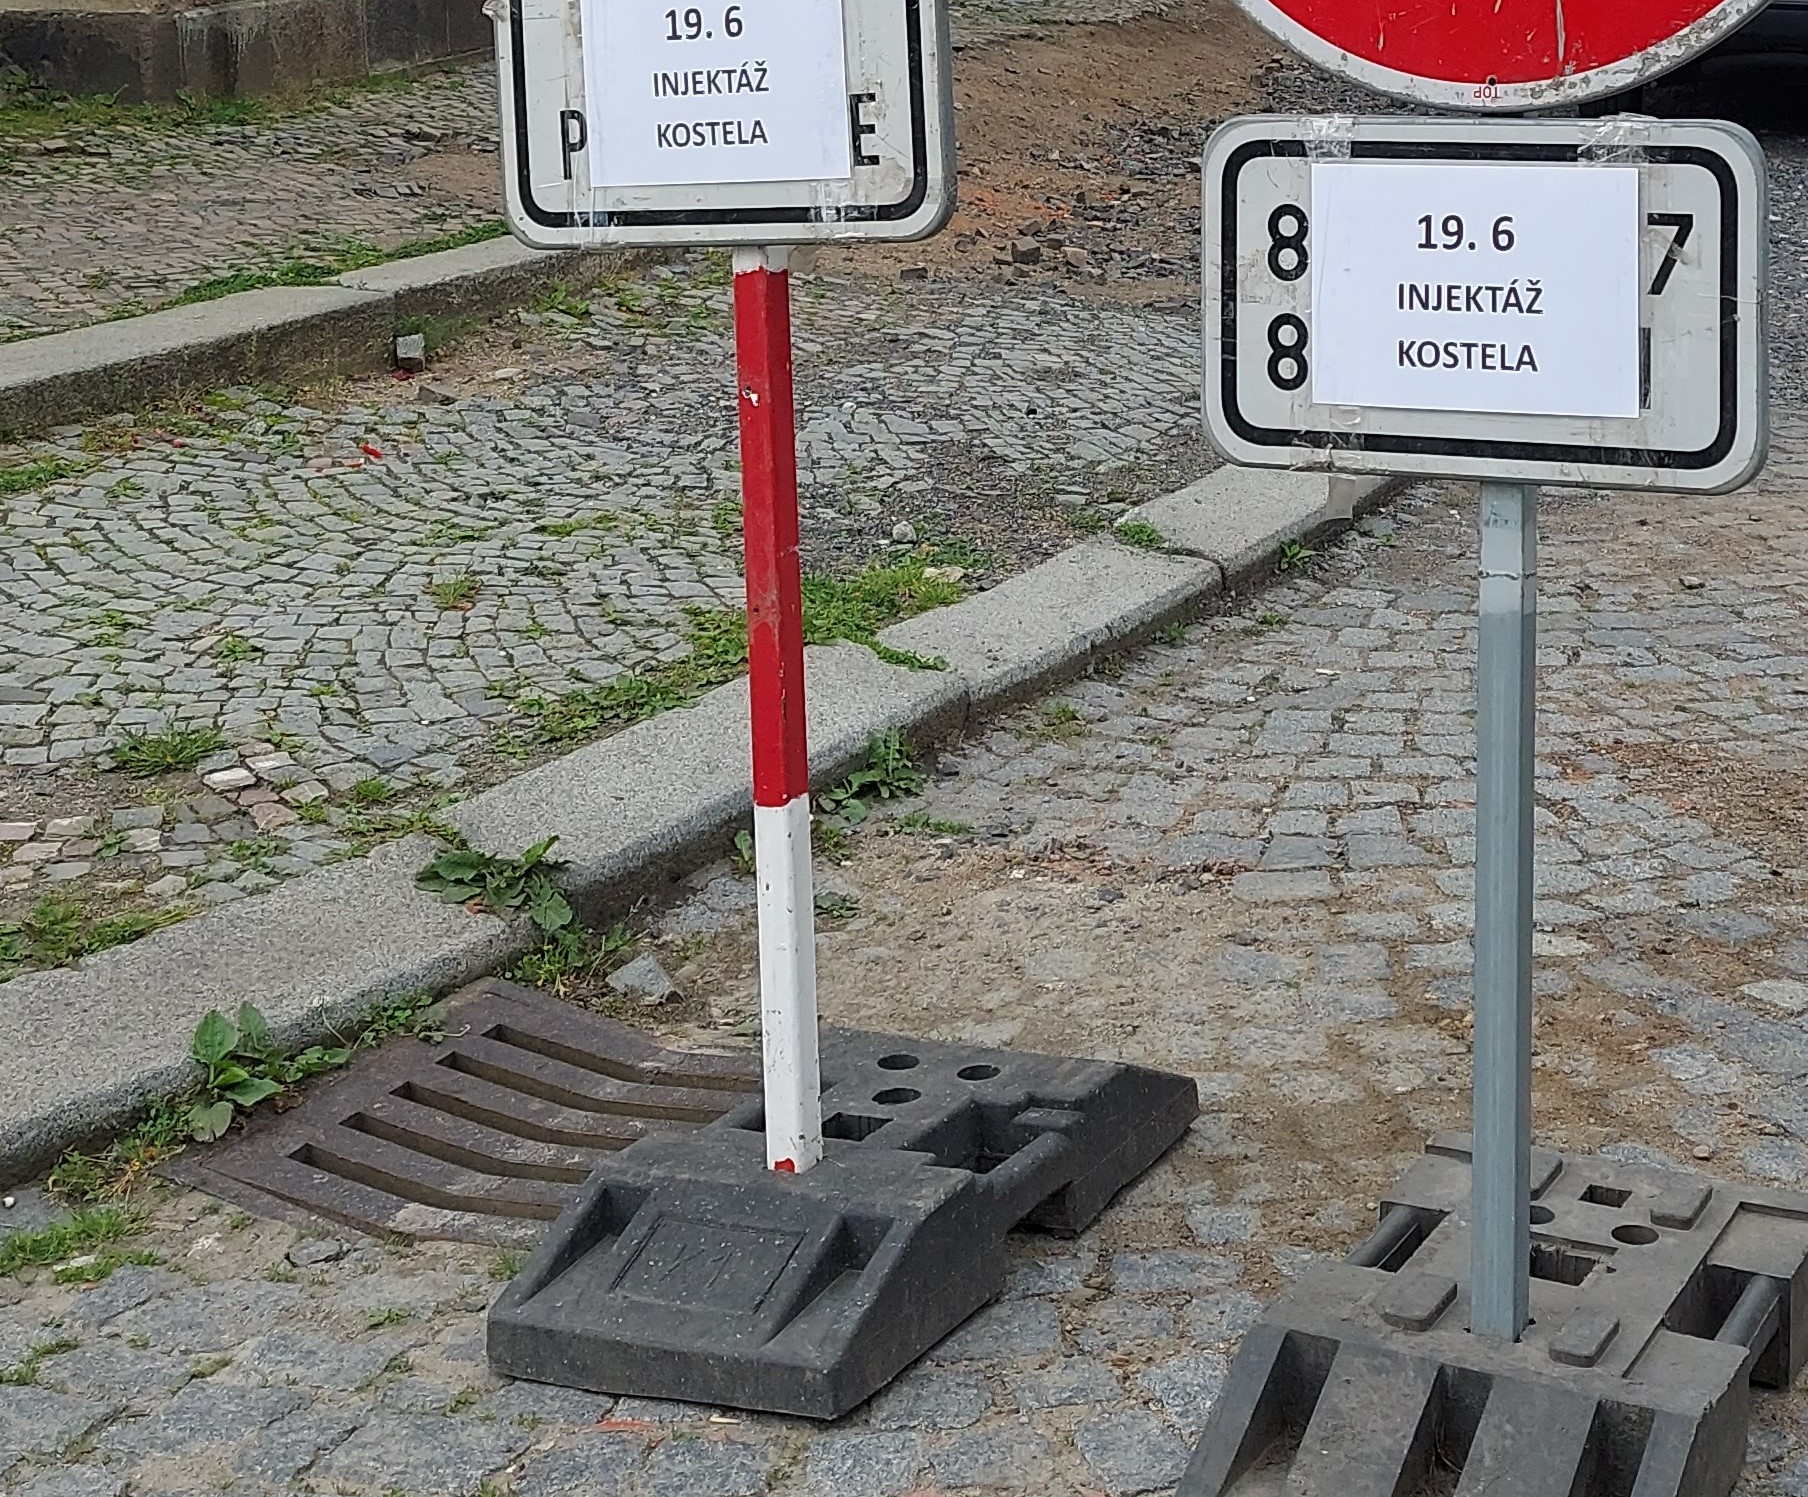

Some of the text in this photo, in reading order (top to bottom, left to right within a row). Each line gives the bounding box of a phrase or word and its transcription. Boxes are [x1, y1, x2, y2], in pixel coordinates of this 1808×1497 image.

[665, 5, 743, 41] 19. 6
[653, 60, 770, 98] INJEKTÁŽ
[1473, 86, 1500, 99] TOP
[559, 109, 588, 180] P
[657, 119, 769, 149] KOSTELA
[851, 92, 880, 166] E
[1267, 204, 1309, 281] 8
[1417, 214, 1515, 252] 19. 6
[1398, 278, 1544, 315] INJEKTÁŽ
[1267, 313, 1309, 391] 8
[1398, 339, 1539, 373] KOSTELA
